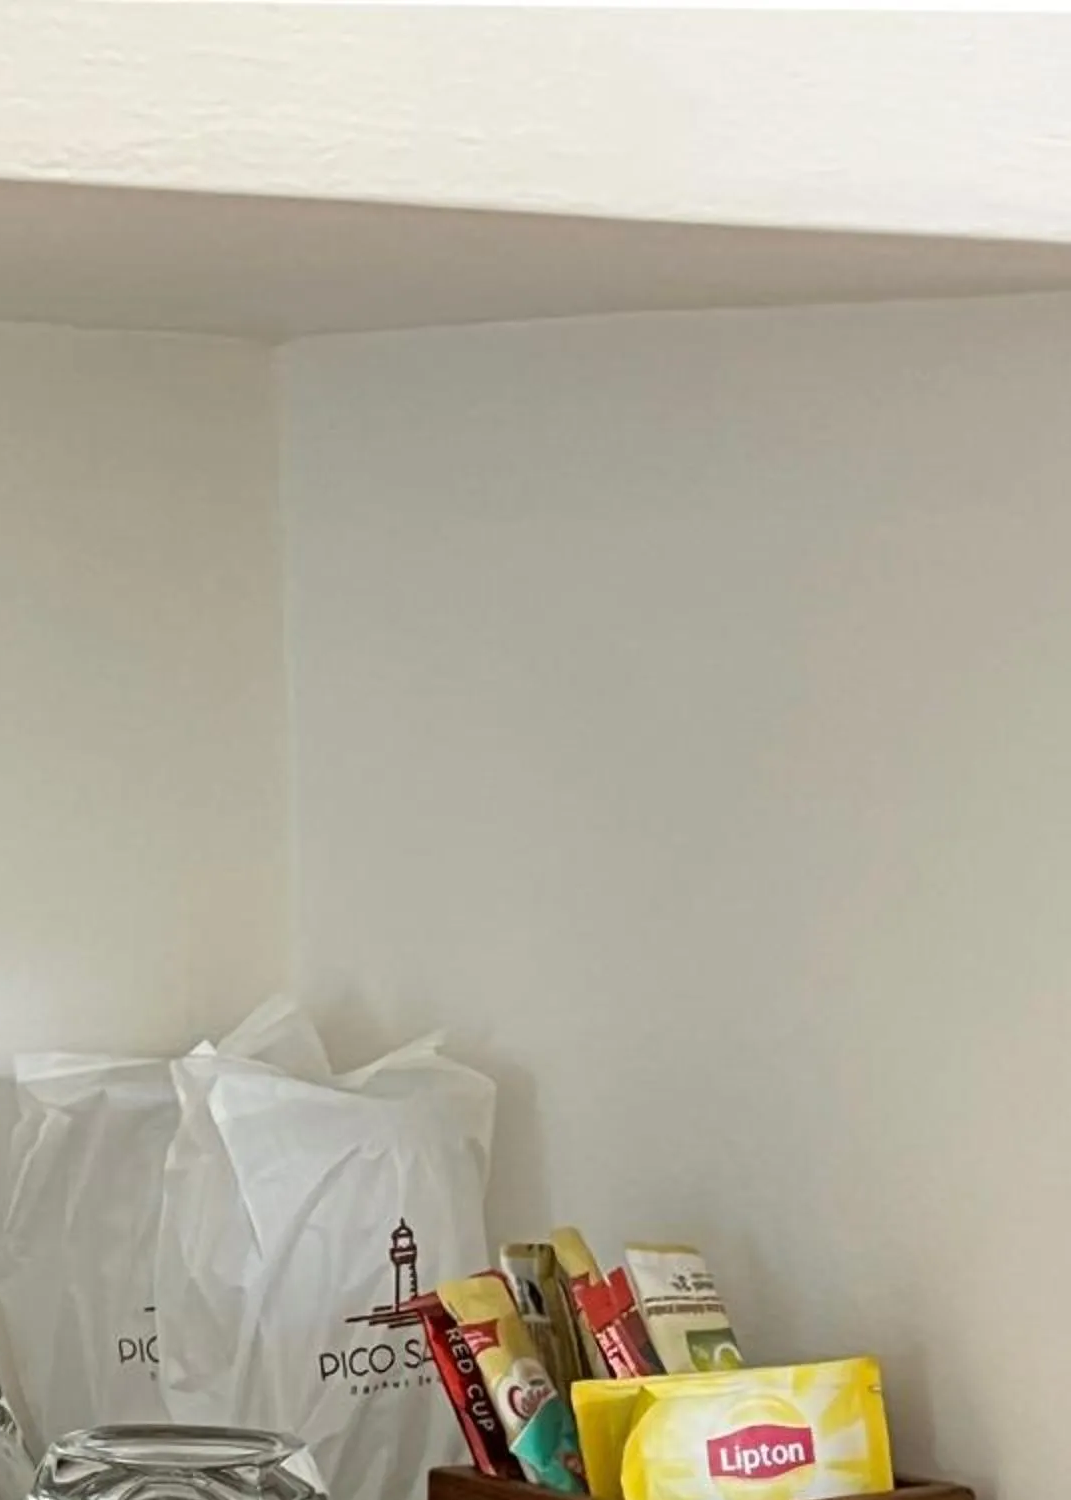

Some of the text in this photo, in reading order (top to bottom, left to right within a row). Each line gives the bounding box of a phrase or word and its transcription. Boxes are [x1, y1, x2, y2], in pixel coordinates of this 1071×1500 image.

[318, 1343, 396, 1381] PICO
[446, 1327, 474, 1374] RED
[467, 1383, 495, 1431] CUP
[720, 1442, 806, 1475] Lipton
